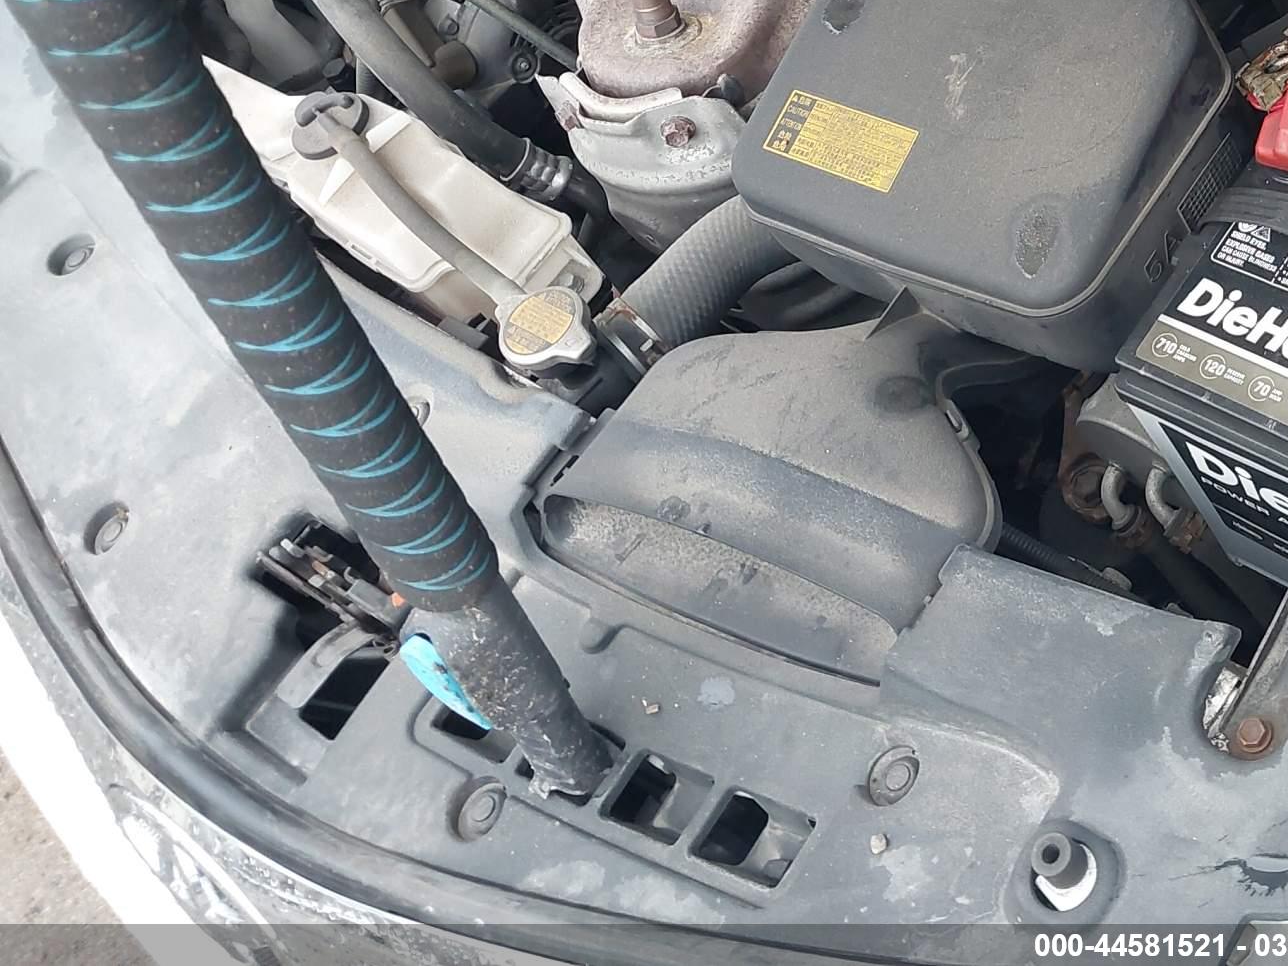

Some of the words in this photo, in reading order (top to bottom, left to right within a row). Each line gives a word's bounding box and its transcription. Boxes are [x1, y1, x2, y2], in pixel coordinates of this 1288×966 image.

[1155, 336, 1178, 355] 710
[1204, 359, 1227, 377] 120
[1253, 381, 1272, 397] 70
[1200, 476, 1271, 516] POWER
